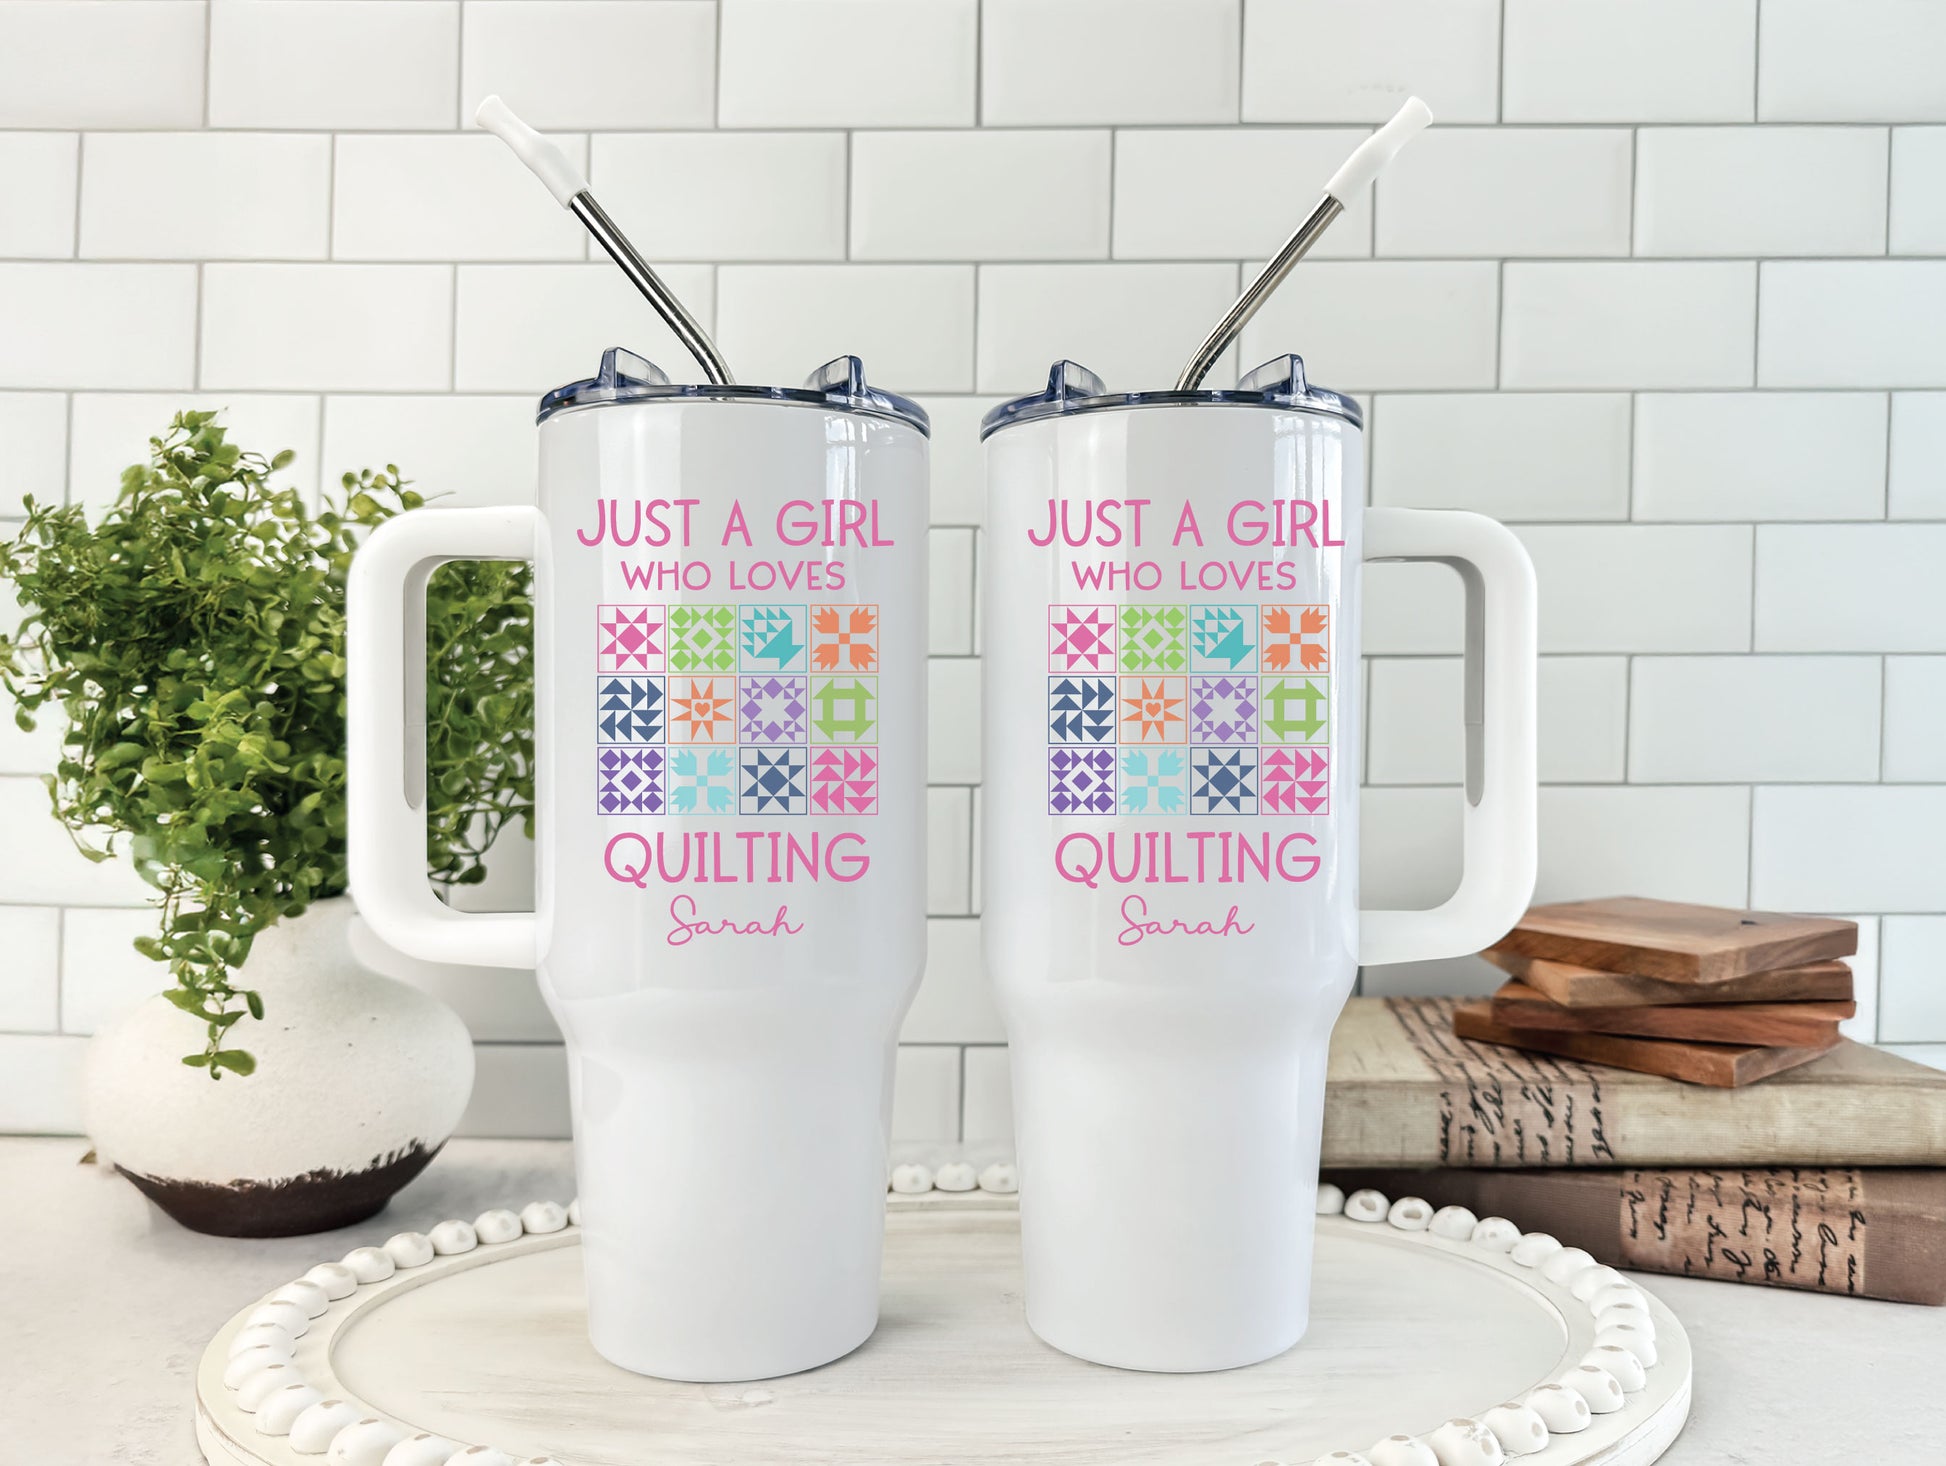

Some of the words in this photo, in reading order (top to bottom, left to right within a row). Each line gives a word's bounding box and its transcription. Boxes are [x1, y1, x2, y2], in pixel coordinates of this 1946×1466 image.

[577, 499, 700, 548] JUST
[722, 500, 752, 547] A
[776, 500, 895, 548] GIRL
[1028, 499, 1150, 548] JUST
[1173, 500, 1203, 547] A
[1227, 500, 1345, 548] GIRL
[621, 561, 711, 590] WHO
[730, 561, 845, 590] LOVES
[1072, 561, 1162, 590] WHO
[1181, 561, 1296, 590] LOVES
[604, 832, 870, 888] QUILTING
[1055, 832, 1320, 889] QUILTING
[667, 895, 803, 946] Sarah
[1118, 895, 1254, 946] Sarah
